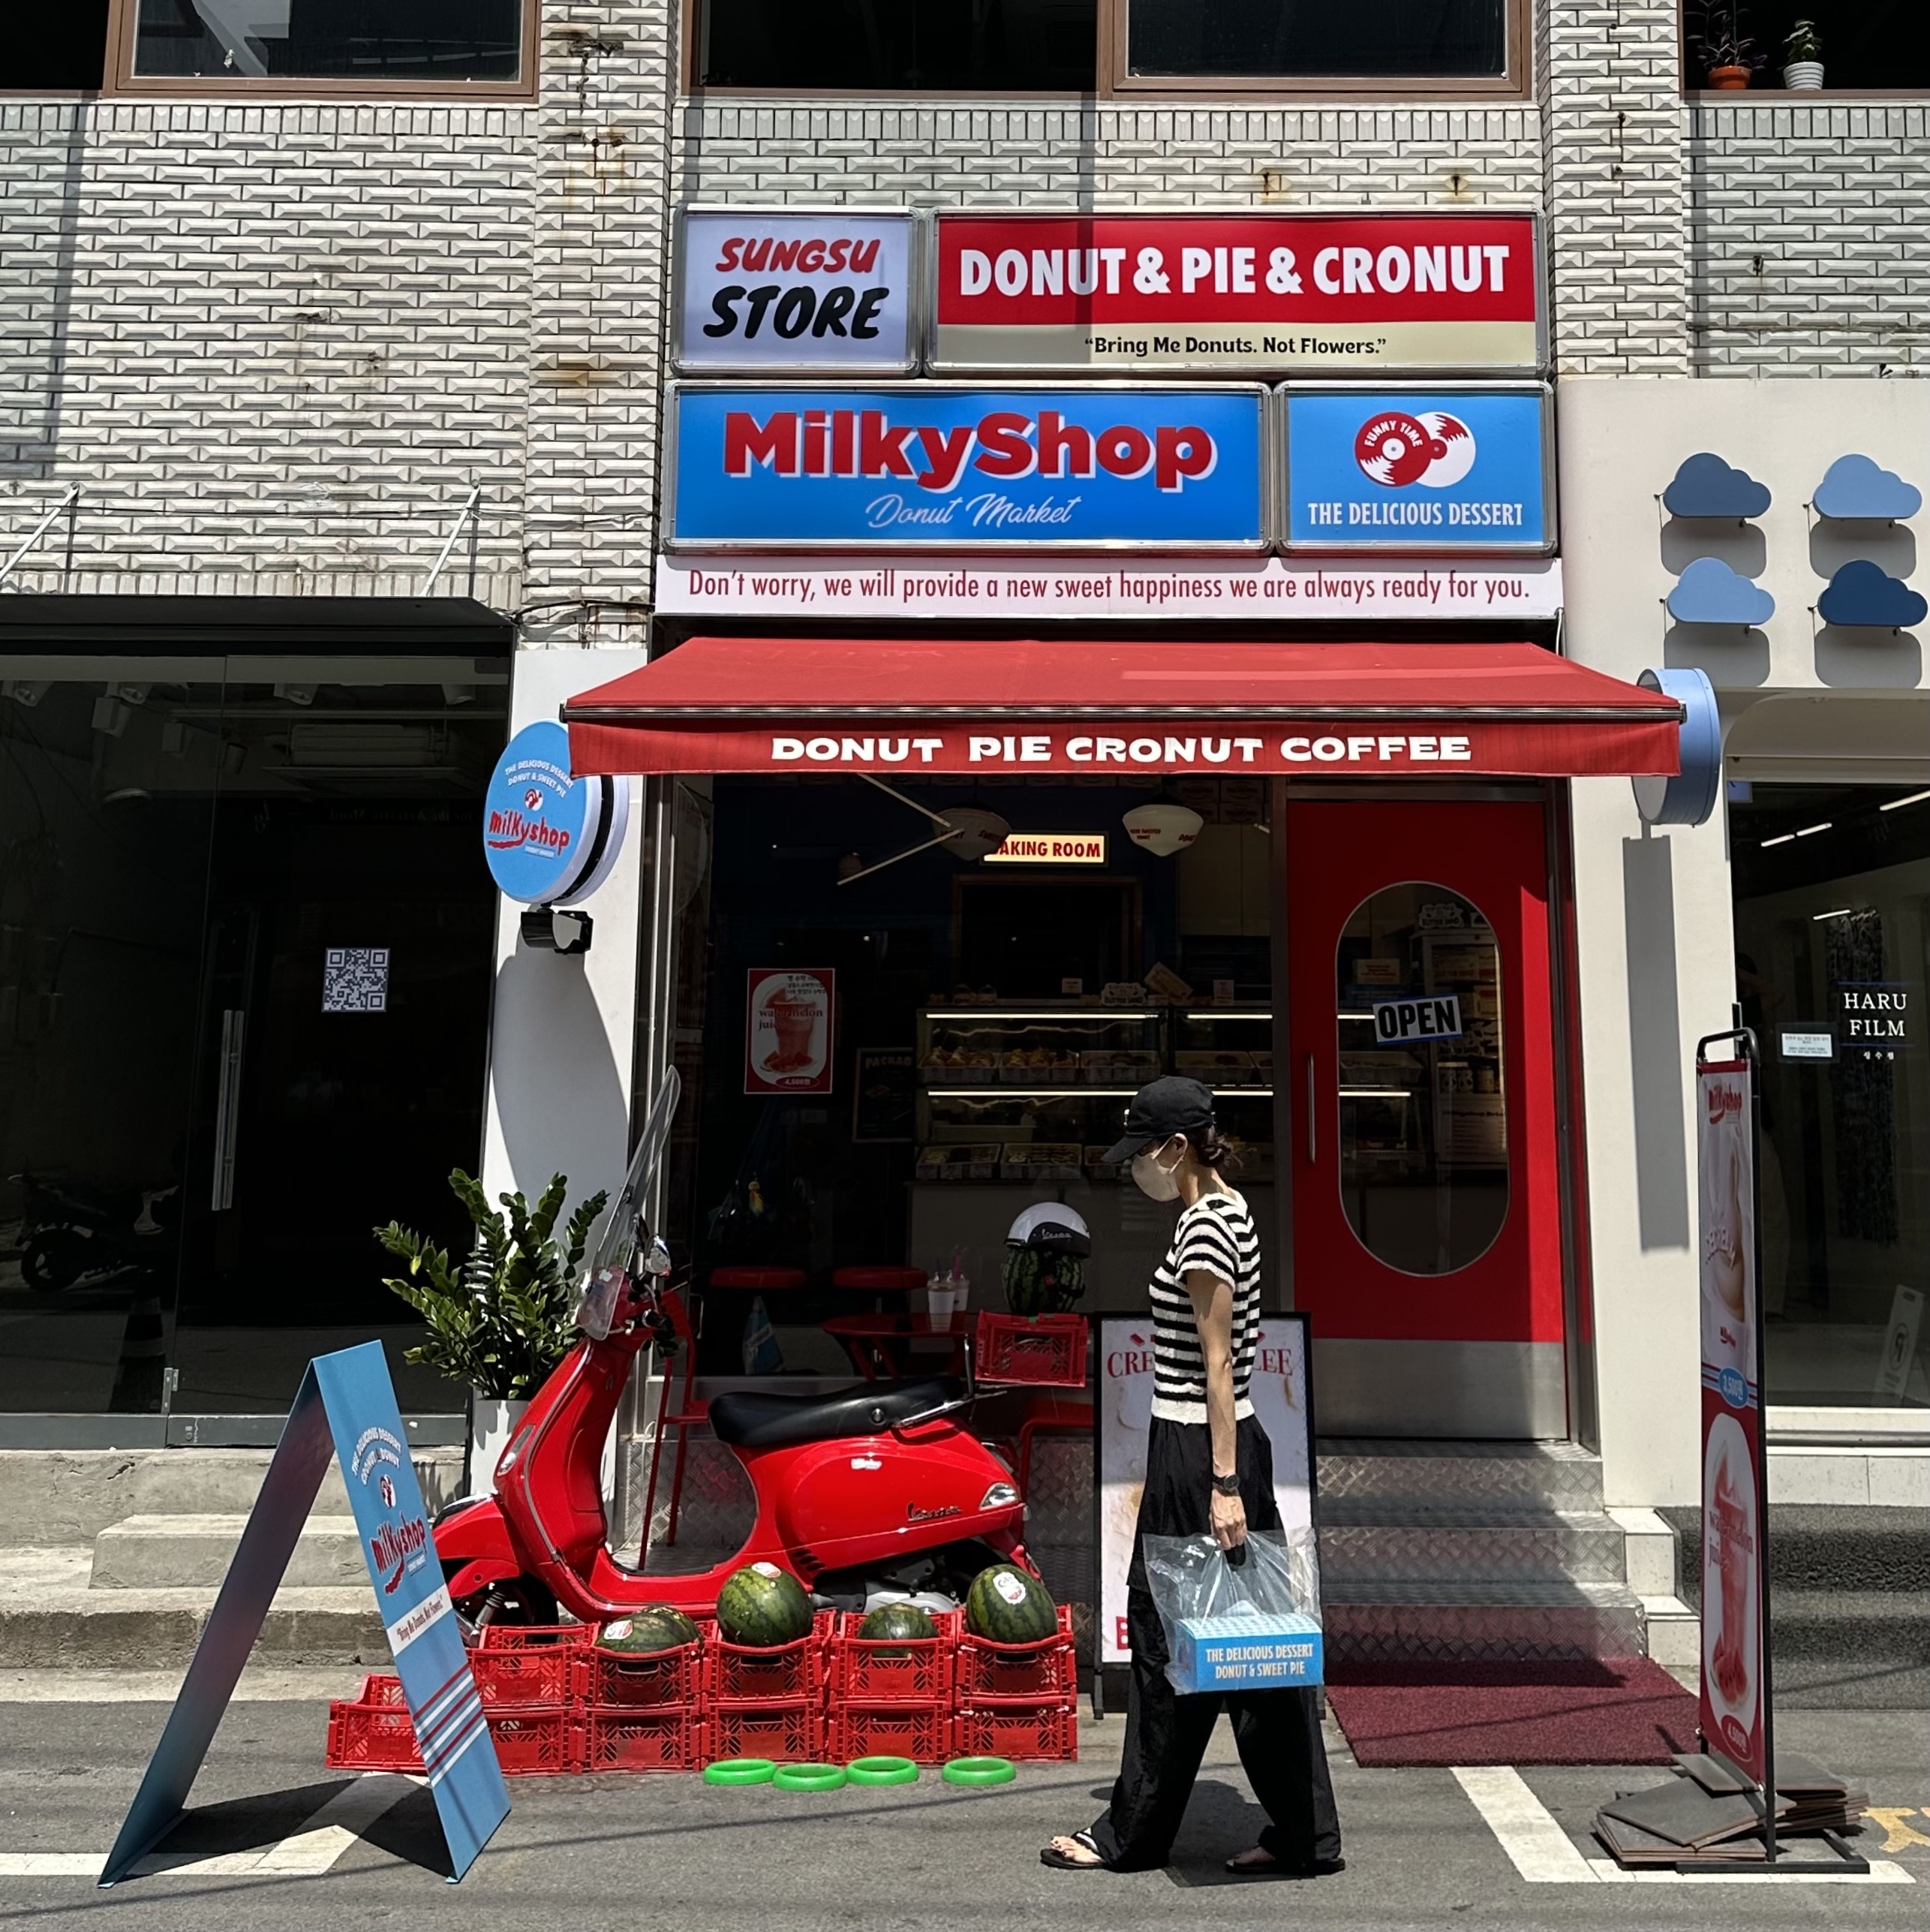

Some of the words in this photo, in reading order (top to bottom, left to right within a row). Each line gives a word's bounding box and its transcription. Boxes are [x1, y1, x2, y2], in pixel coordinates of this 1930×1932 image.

[715, 237, 881, 273] SUNGSU
[960, 248, 1126, 296] DONUT
[1133, 247, 1172, 294] &
[1182, 247, 1256, 293] PIE
[1266, 246, 1303, 294] &
[1313, 245, 1510, 294] CRONUT
[702, 284, 890, 340] STORE
[1154, 337, 1180, 354] Me
[1186, 337, 1258, 354] Donuts.
[1263, 337, 1295, 354] Not
[1364, 420, 1397, 447] FUNNY
[1399, 422, 1423, 448] TIME
[723, 409, 1217, 493] MilkyShop
[865, 494, 963, 528] Donut
[965, 492, 1081, 527] Market
[1309, 502, 1342, 525] THE
[1348, 502, 1442, 525] DELICIOUS
[1448, 503, 1523, 525] DESSERT
[752, 576, 816, 603] worry,
[825, 579, 852, 597] we
[859, 570, 895, 597] will
[903, 570, 979, 603] provide
[987, 579, 998, 597] a
[1006, 579, 1048, 597] new
[1054, 573, 1111, 598] sweet
[1120, 570, 1222, 604] happiness
[1230, 579, 1258, 597] we
[1264, 579, 1297, 598] are
[1304, 570, 1375, 604] always
[1383, 570, 1441, 604] ready
[1448, 570, 1478, 598] for
[1485, 579, 1529, 604] you.
[771, 737, 943, 763] DONUT
[969, 736, 1052, 762] PIE
[1066, 736, 1264, 763] CRONUT
[1280, 736, 1472, 762] COFFEE
[504, 763, 517, 775] THE
[518, 759, 550, 771] DELICIOUS
[550, 764, 575, 789] DESSERT
[508, 772, 531, 787] DONUT
[531, 772, 537, 781] &
[537, 773, 557, 789] SWEET
[556, 784, 567, 799] PIE
[998, 841, 1048, 857] AKING
[1052, 841, 1101, 858] ROOM
[1844, 992, 1907, 1010] HARU
[1377, 999, 1457, 1040] OPEN
[1850, 1019, 1905, 1037] FILM
[1205, 1648, 1225, 1663] THE
[1226, 1645, 1273, 1662] DELICIOUS
[1276, 1643, 1314, 1659] DESSERT
[1215, 1663, 1247, 1679] DONUT
[1249, 1663, 1255, 1678] &
[1257, 1662, 1288, 1678] SWEET
[1290, 1661, 1306, 1675] PIE
